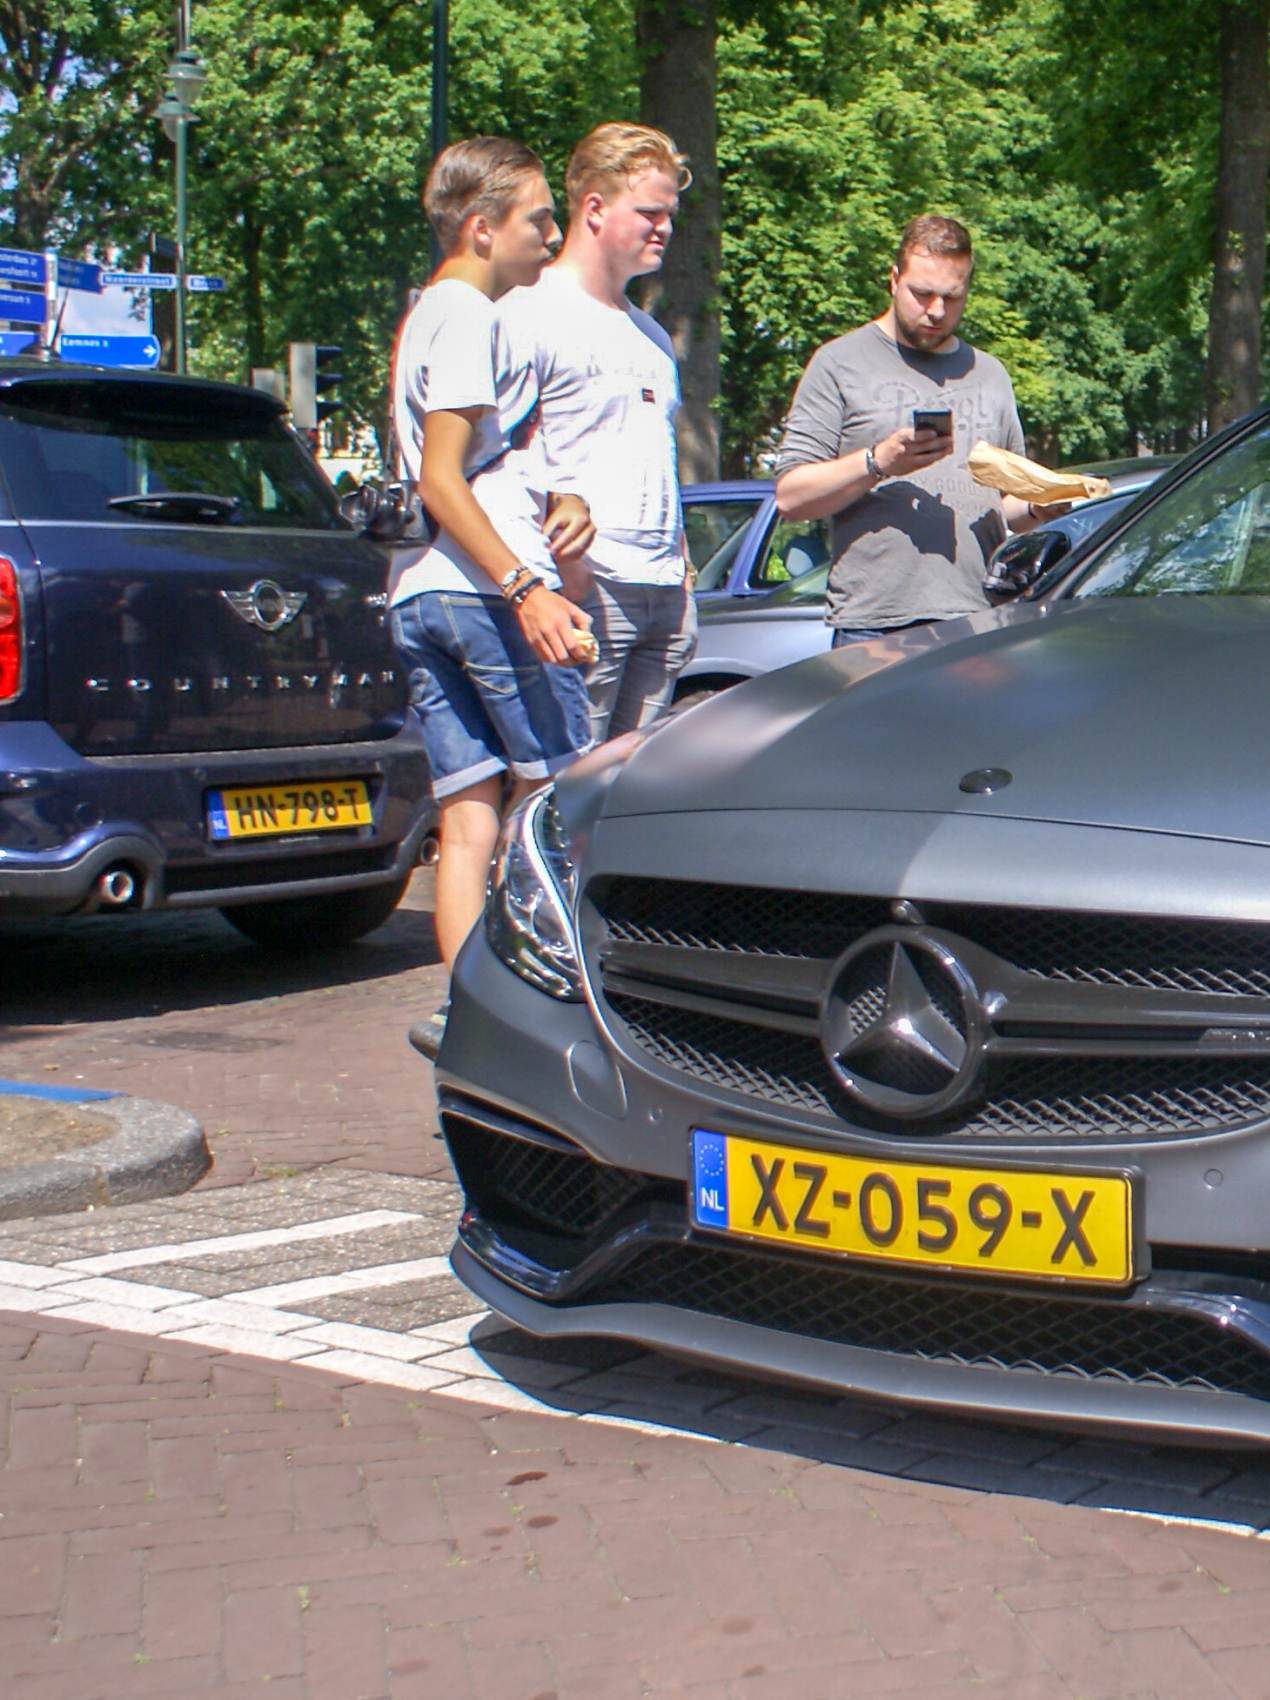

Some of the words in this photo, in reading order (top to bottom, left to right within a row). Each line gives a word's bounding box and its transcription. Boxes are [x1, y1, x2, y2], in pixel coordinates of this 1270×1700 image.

[85, 670, 395, 691] COUNTRYMAN
[234, 787, 360, 830] HN-798-T
[701, 1186, 724, 1212] NL
[751, 1153, 1098, 1267] XZ-059-X
